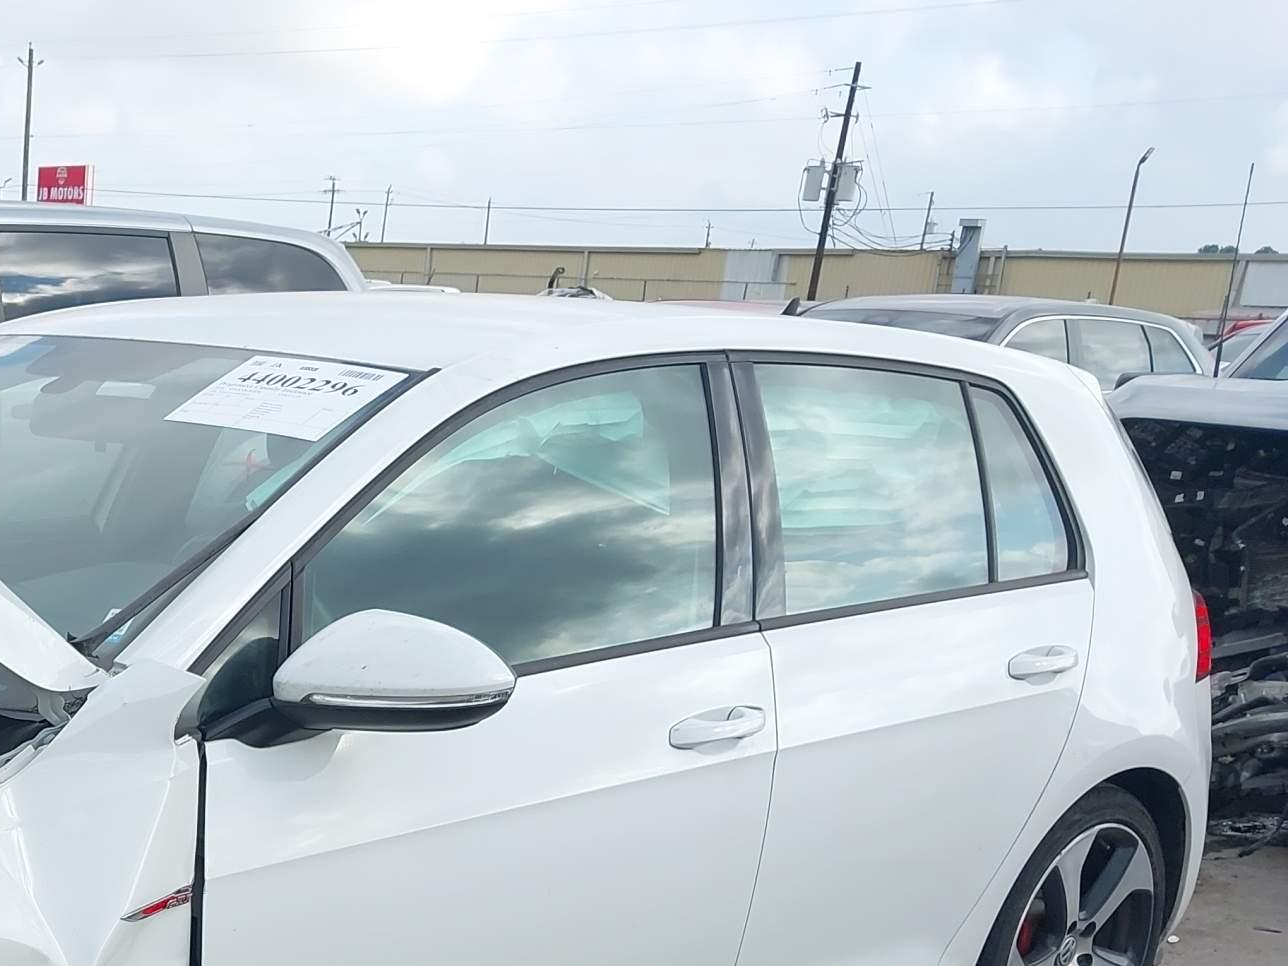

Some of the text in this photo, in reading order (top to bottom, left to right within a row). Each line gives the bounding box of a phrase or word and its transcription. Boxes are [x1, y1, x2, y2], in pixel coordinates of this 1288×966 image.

[38, 186, 84, 201] JB MOTORS
[238, 371, 365, 397] 44002296
